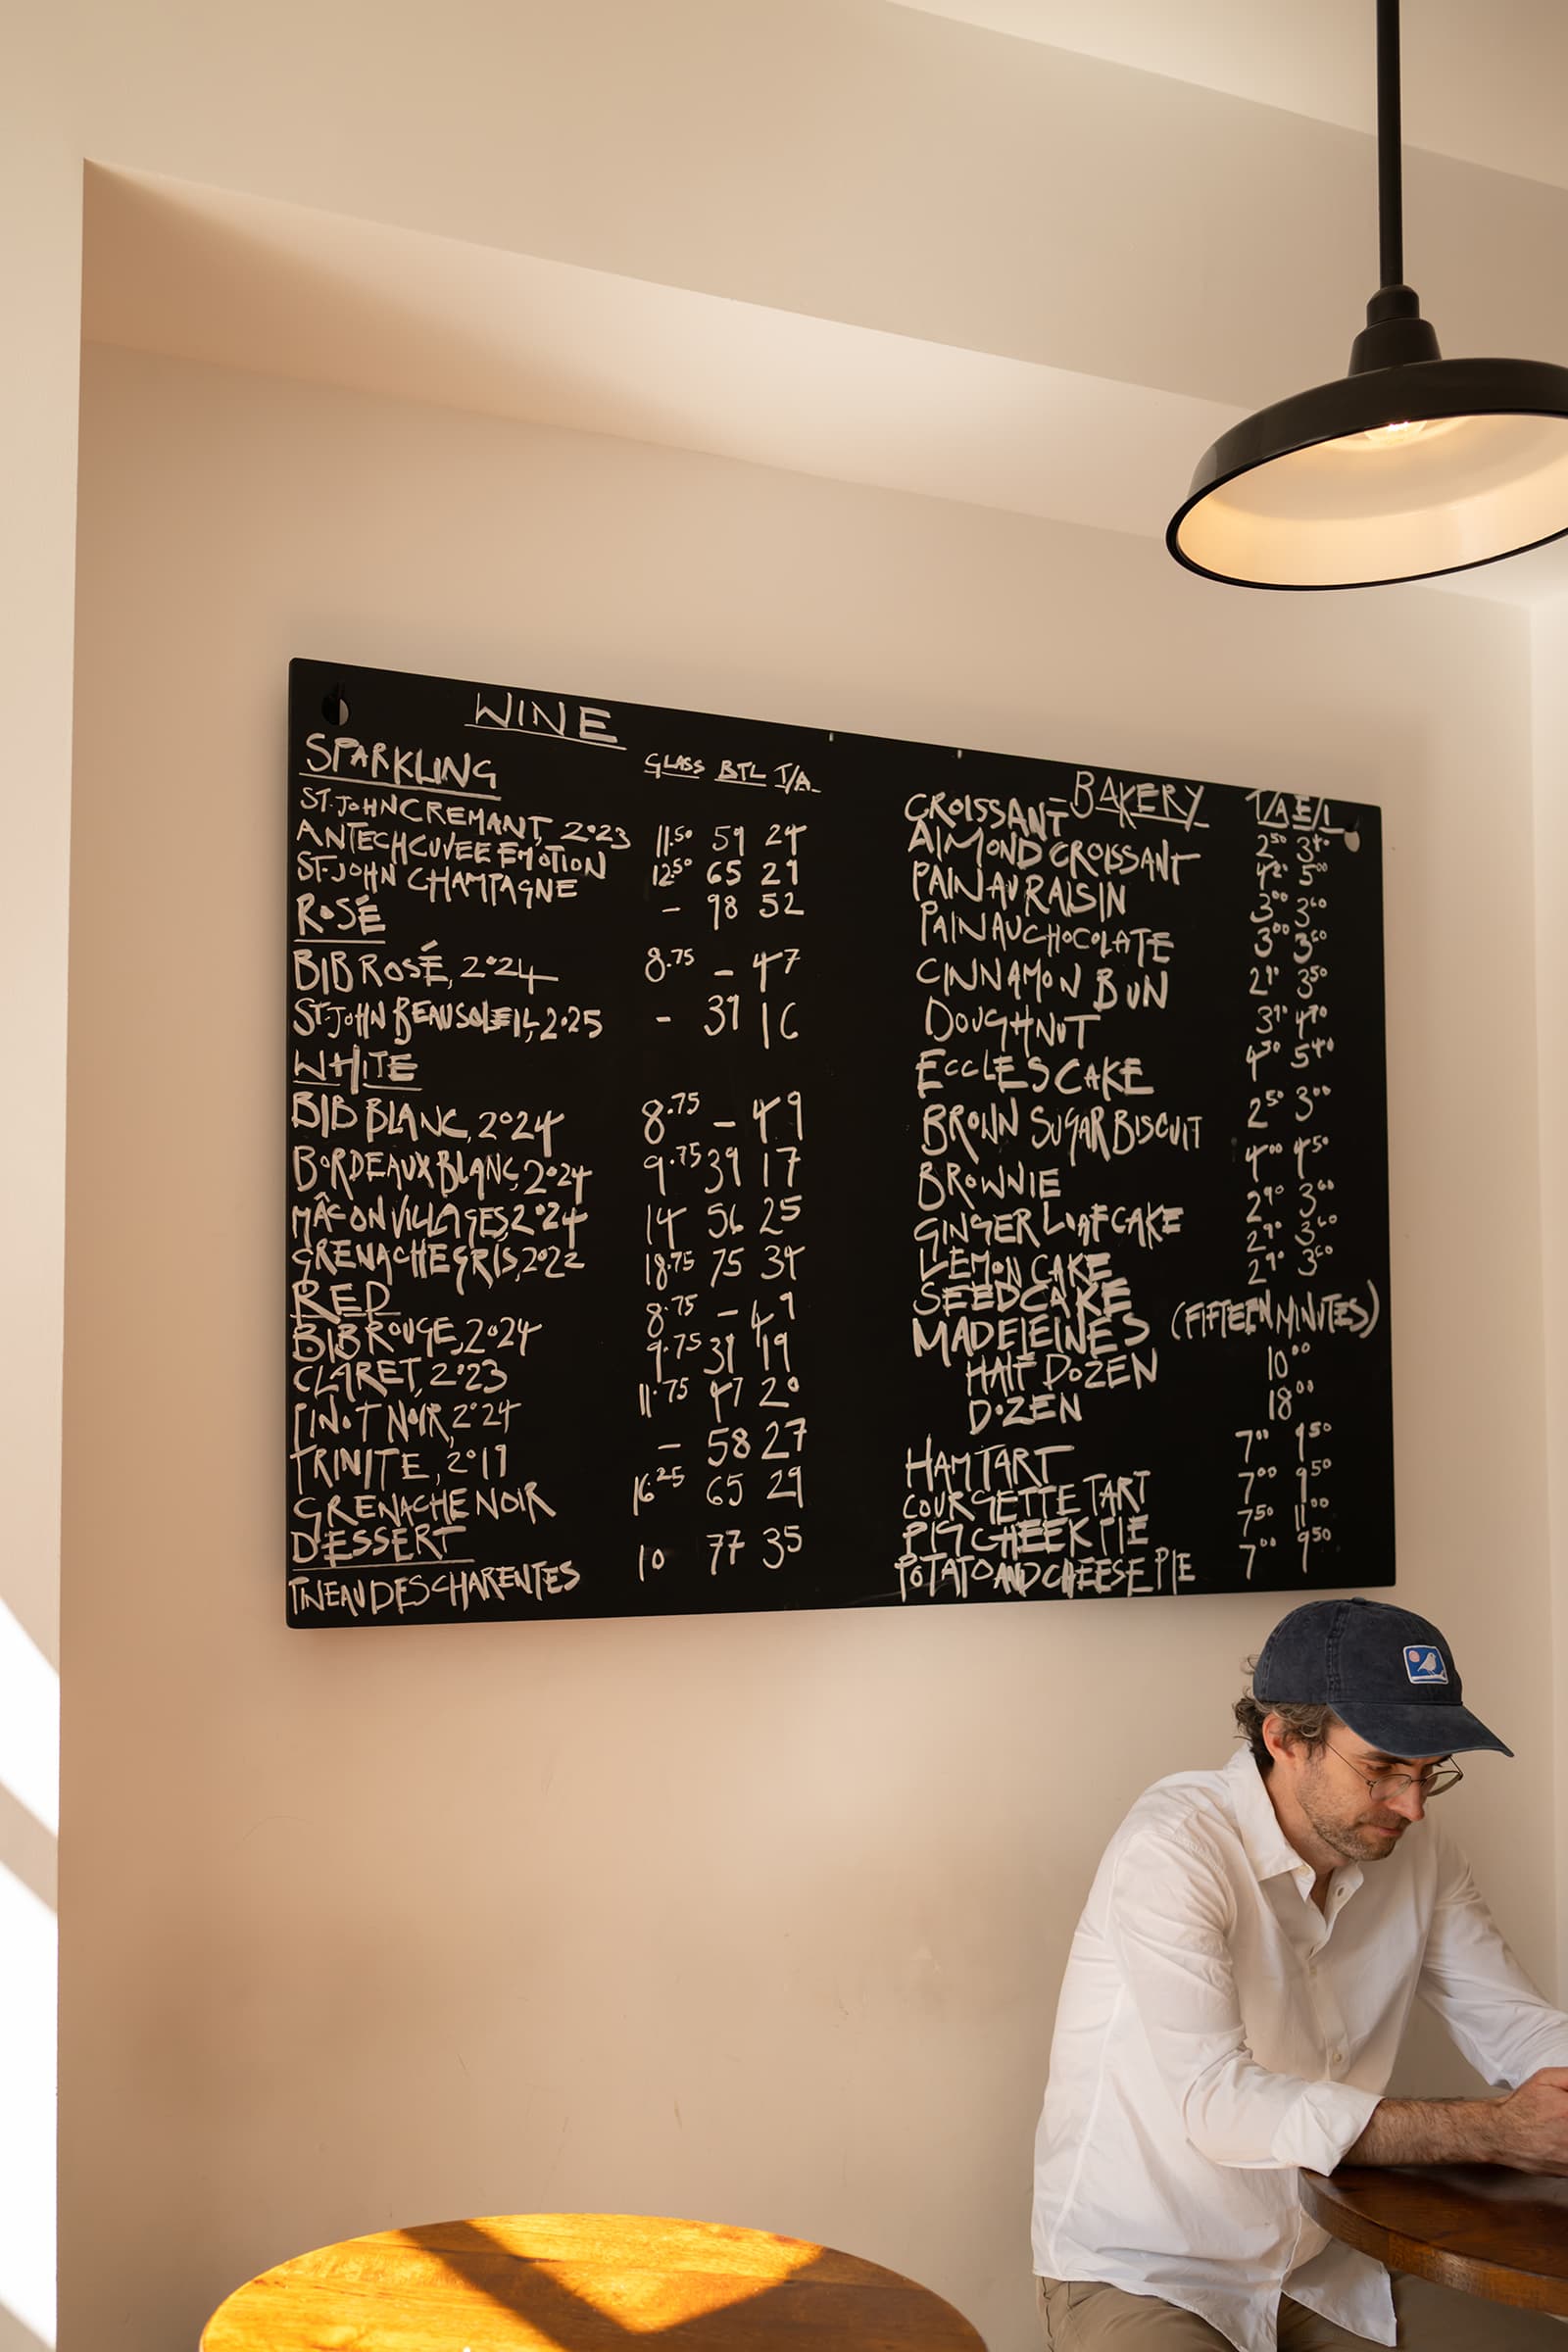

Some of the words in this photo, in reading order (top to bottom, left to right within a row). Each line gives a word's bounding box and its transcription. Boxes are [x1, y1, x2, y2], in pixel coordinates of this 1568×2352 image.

[475, 692, 617, 743] WINE
[306, 733, 497, 790] SPARKLING
[644, 753, 706, 779] GLASS
[717, 760, 766, 782] BTL
[904, 791, 1070, 842] CROISSANT
[1069, 770, 1205, 833] BAKERY
[297, 818, 409, 865] ANTECH
[409, 831, 491, 863] CUVEE
[497, 841, 607, 880] EMOTION
[707, 859, 742, 886] 65
[560, 821, 631, 850] 2023
[711, 825, 745, 857] 59
[764, 823, 808, 857] 24
[1049, 838, 1201, 886] CROISSANT
[296, 893, 385, 936] ROSÉ
[407, 865, 578, 909] CHAMPAGNE
[707, 893, 739, 931] 98
[759, 891, 805, 918] 52
[912, 859, 984, 903] PAIN
[986, 870, 1018, 910] AU
[1024, 873, 1126, 923] RAISIN
[920, 900, 986, 947] PAIN
[992, 910, 1022, 952] AU
[1022, 923, 1174, 968] CHOCOLATE
[293, 949, 354, 995] BIB
[461, 956, 559, 995] 2024
[752, 948, 801, 994] 47
[915, 956, 1081, 1004] CINNAMON
[1093, 967, 1168, 1011] BUN
[761, 1002, 800, 1050] 16
[925, 995, 1102, 1058] DOUGHNUT
[294, 1045, 418, 1095] WHITE
[915, 1048, 1050, 1100] ECCLES
[1054, 1055, 1154, 1102] CAKE
[291, 1092, 358, 1139] BIB
[478, 1109, 564, 1158] 2024
[752, 1091, 804, 1145] 49
[921, 1097, 1019, 1165] BROWN
[1030, 1104, 1111, 1167] SUGAR
[1111, 1108, 1202, 1155] BISCUIT
[293, 1145, 435, 1200] BORDEAUX
[523, 1159, 593, 1205] 2024
[704, 1147, 742, 1195] 39
[762, 1147, 802, 1188] 17
[917, 1160, 1061, 1212] BROWNIE
[511, 1201, 588, 1250] 2024
[647, 1203, 687, 1250] 14
[707, 1202, 745, 1239] 56
[759, 1195, 803, 1236] 25
[913, 1207, 1041, 1263] GINGER
[1043, 1200, 1108, 1248] LOAF
[1111, 1201, 1184, 1250] CAKE
[292, 1238, 451, 1289] GRENACHE
[521, 1246, 585, 1279] 2022
[710, 1247, 745, 1288] 75
[760, 1245, 807, 1281] 34
[919, 1246, 1022, 1289] LEMON
[1031, 1251, 1112, 1298] CAKE
[292, 1280, 392, 1325] RED
[293, 1323, 361, 1363] BIB
[464, 1316, 542, 1356] 2024
[751, 1291, 796, 1348] 49
[430, 1358, 508, 1394] 2023
[762, 1332, 791, 1372] 19
[1043, 1348, 1158, 1391] DOZEN
[452, 1399, 521, 1434] 2024
[710, 1377, 744, 1423] 47
[759, 1376, 800, 1408] 20
[969, 1392, 1082, 1436] DOZEN
[708, 1427, 752, 1467] 58
[761, 1417, 808, 1460] 27
[906, 1433, 972, 1494] HAM
[974, 1444, 1075, 1492] TART
[293, 1487, 470, 1544] GRENACHE
[476, 1481, 557, 1526] NOIR
[706, 1473, 744, 1507] 65
[766, 1465, 804, 1509] 29
[903, 1484, 1081, 1525] COURGETTE
[1083, 1470, 1151, 1517] TART
[291, 1523, 466, 1568] DESSERT
[903, 1520, 964, 1556] PIG
[970, 1516, 1093, 1560] CHEEK
[1100, 1514, 1150, 1556] PIE
[370, 1574, 430, 1615] DES
[431, 1559, 580, 1612] CHARENTES
[639, 1544, 664, 1583] 10
[706, 1529, 746, 1576] 77
[762, 1525, 803, 1569] 35
[894, 1552, 993, 1602] POTATO
[993, 1562, 1042, 1597] AND
[1042, 1556, 1154, 1598] CHEESE
[1154, 1546, 1196, 1595] PIE
